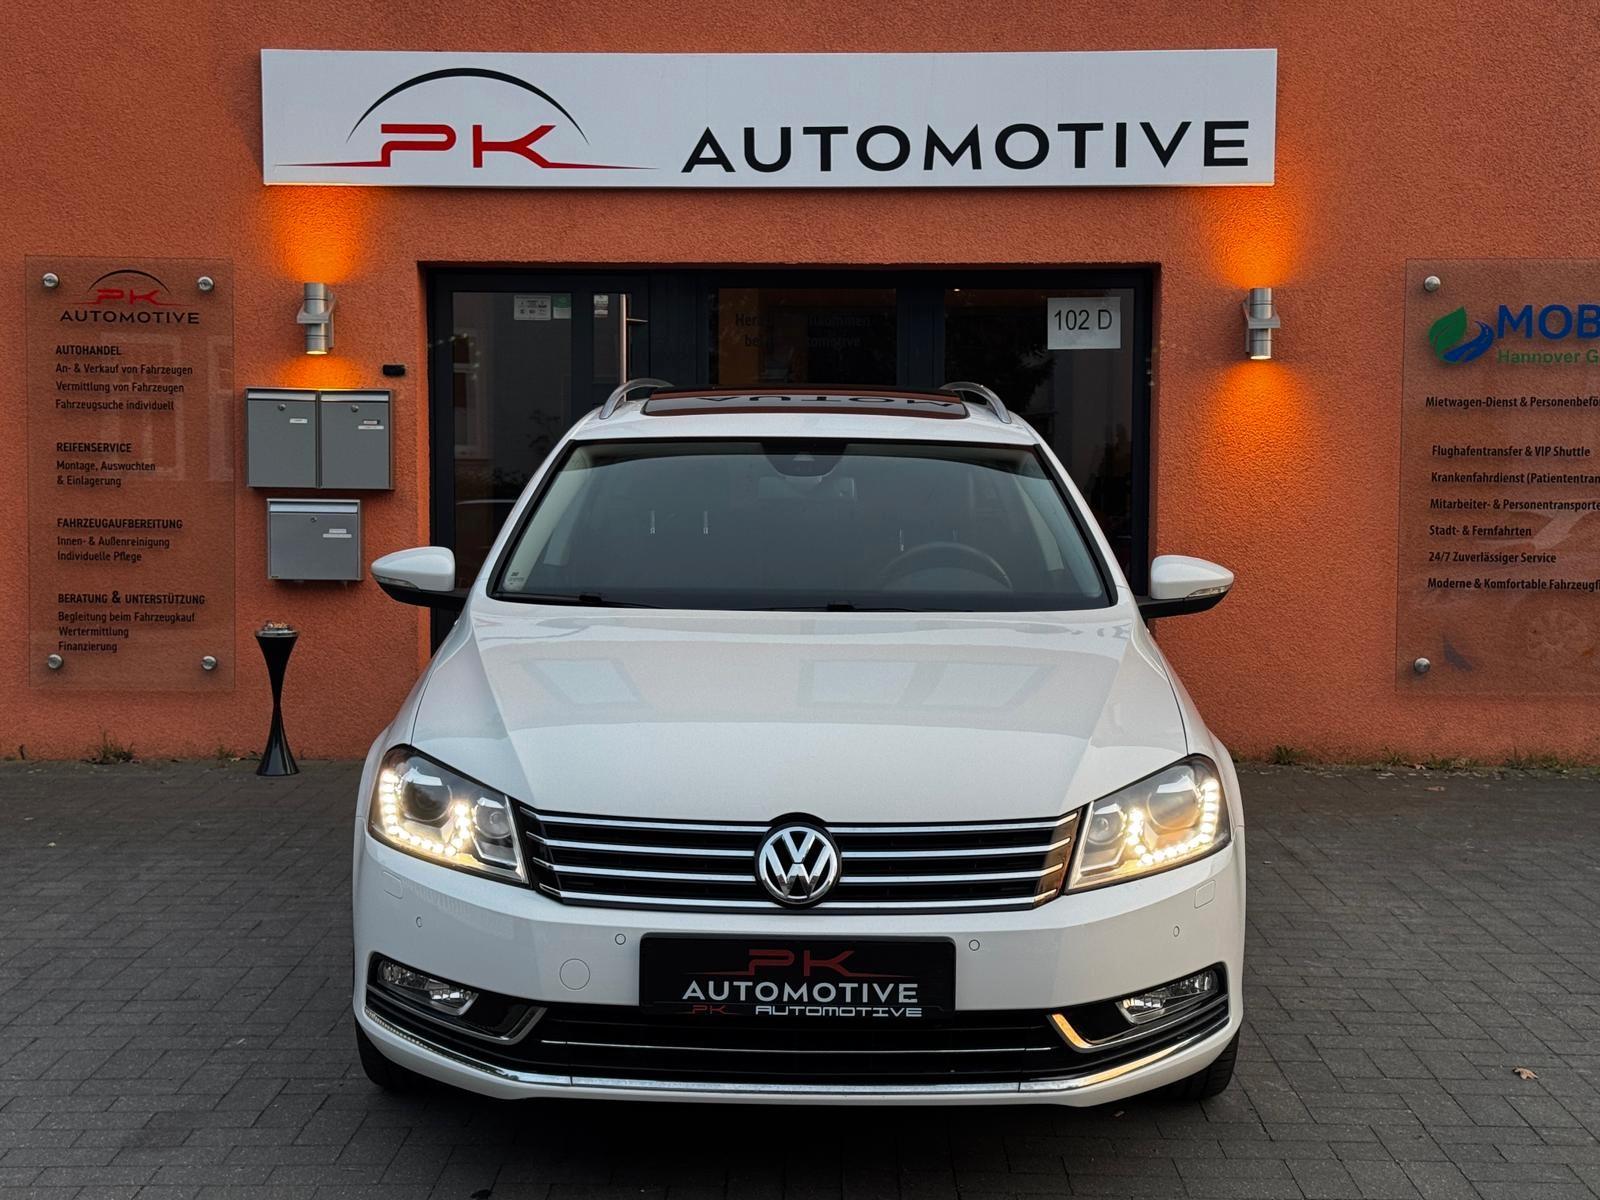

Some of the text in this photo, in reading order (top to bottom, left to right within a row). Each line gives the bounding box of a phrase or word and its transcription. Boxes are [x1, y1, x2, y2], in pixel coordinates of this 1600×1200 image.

[381, 120, 1250, 173] PK AUTOMOTIVE
[60, 310, 200, 325] AUTOMOTIVE
[1054, 309, 1112, 331] 102 D
[1498, 304, 1600, 340] MOB
[55, 344, 122, 356] AUTOHANDEL
[1498, 350, 1581, 364] Hannover
[55, 363, 193, 377] An- & Verkauf von Fahrzeugen
[55, 381, 184, 395] Vermittlung von Fahrzeugen
[55, 399, 175, 412] Fahrzeugsuche individuell
[1425, 396, 1600, 409] Mietwagen-Dienst & Personenbefö
[56, 442, 132, 454] REIFENSERVICE
[1432, 445, 1591, 459] Flughafentransfer & VIP Shuttle
[56, 460, 156, 473] Montage, Auswuchten
[57, 476, 122, 488] & Einlagerung
[1431, 472, 1525, 484] Krankenfahrdienst
[1430, 498, 1491, 510] Mitarbeiter-
[1493, 499, 1500, 510] &
[57, 517, 183, 529] FAHRZEUGAUFBEREITUNG
[1429, 525, 1532, 537] Stadt- & Fernfahrten
[57, 536, 170, 549] Innen- & Außenreinigung
[57, 551, 142, 563] Individuelle Pflege
[1428, 551, 1557, 565] 24/7 Zuverlässiger Service
[1427, 577, 1472, 589] Moderne
[1474, 578, 1482, 589] &
[1484, 578, 1547, 590] Komfortable
[58, 590, 205, 605] BERATUNG & UNTERSTÜTZUNG
[58, 611, 195, 624] Begleitung beim Fahrzeugkauf
[58, 627, 129, 639] Wertermittlung
[58, 641, 118, 653] Finanzierung
[749, 949, 855, 977] PK
[682, 980, 918, 1003] AUTOMOTIVE
[755, 1005, 922, 1018] AUTOMOTIVE
